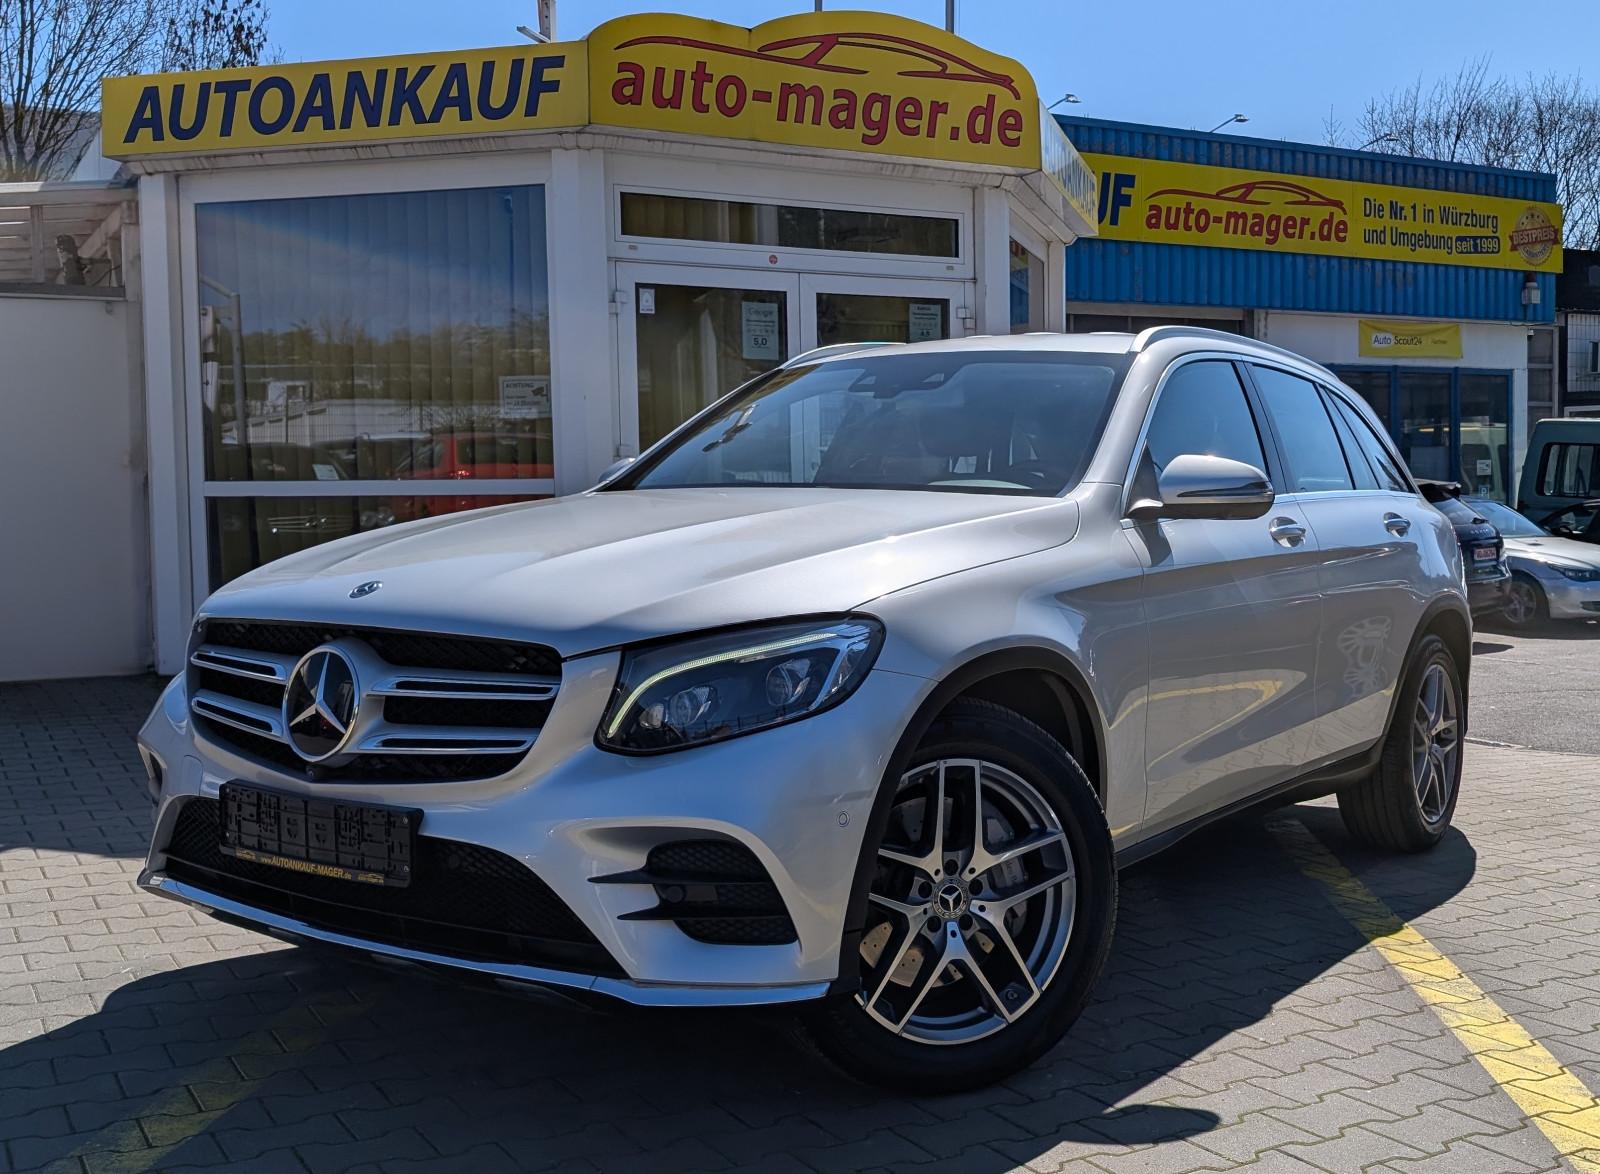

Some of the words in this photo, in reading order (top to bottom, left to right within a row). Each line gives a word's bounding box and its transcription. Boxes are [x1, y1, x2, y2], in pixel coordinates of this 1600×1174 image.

[123, 55, 567, 145] AUTOANKAUF
[610, 60, 1024, 148] auto-mager.de
[1146, 202, 1348, 246] auto-mager.de
[1363, 197, 1385, 219] Die
[1389, 199, 1408, 222] Nr.
[1411, 202, 1418, 223] 1
[1423, 204, 1435, 224] in
[1439, 204, 1499, 234] Würzburg
[1363, 225, 1386, 245] und
[1390, 225, 1454, 255] Umgebung
[1456, 237, 1474, 253] seit
[1476, 237, 1499, 253] 1999
[1513, 228, 1555, 245] BESTPREIS
[1373, 334, 1392, 346] Auto
[1393, 335, 1423, 347] Scout24
